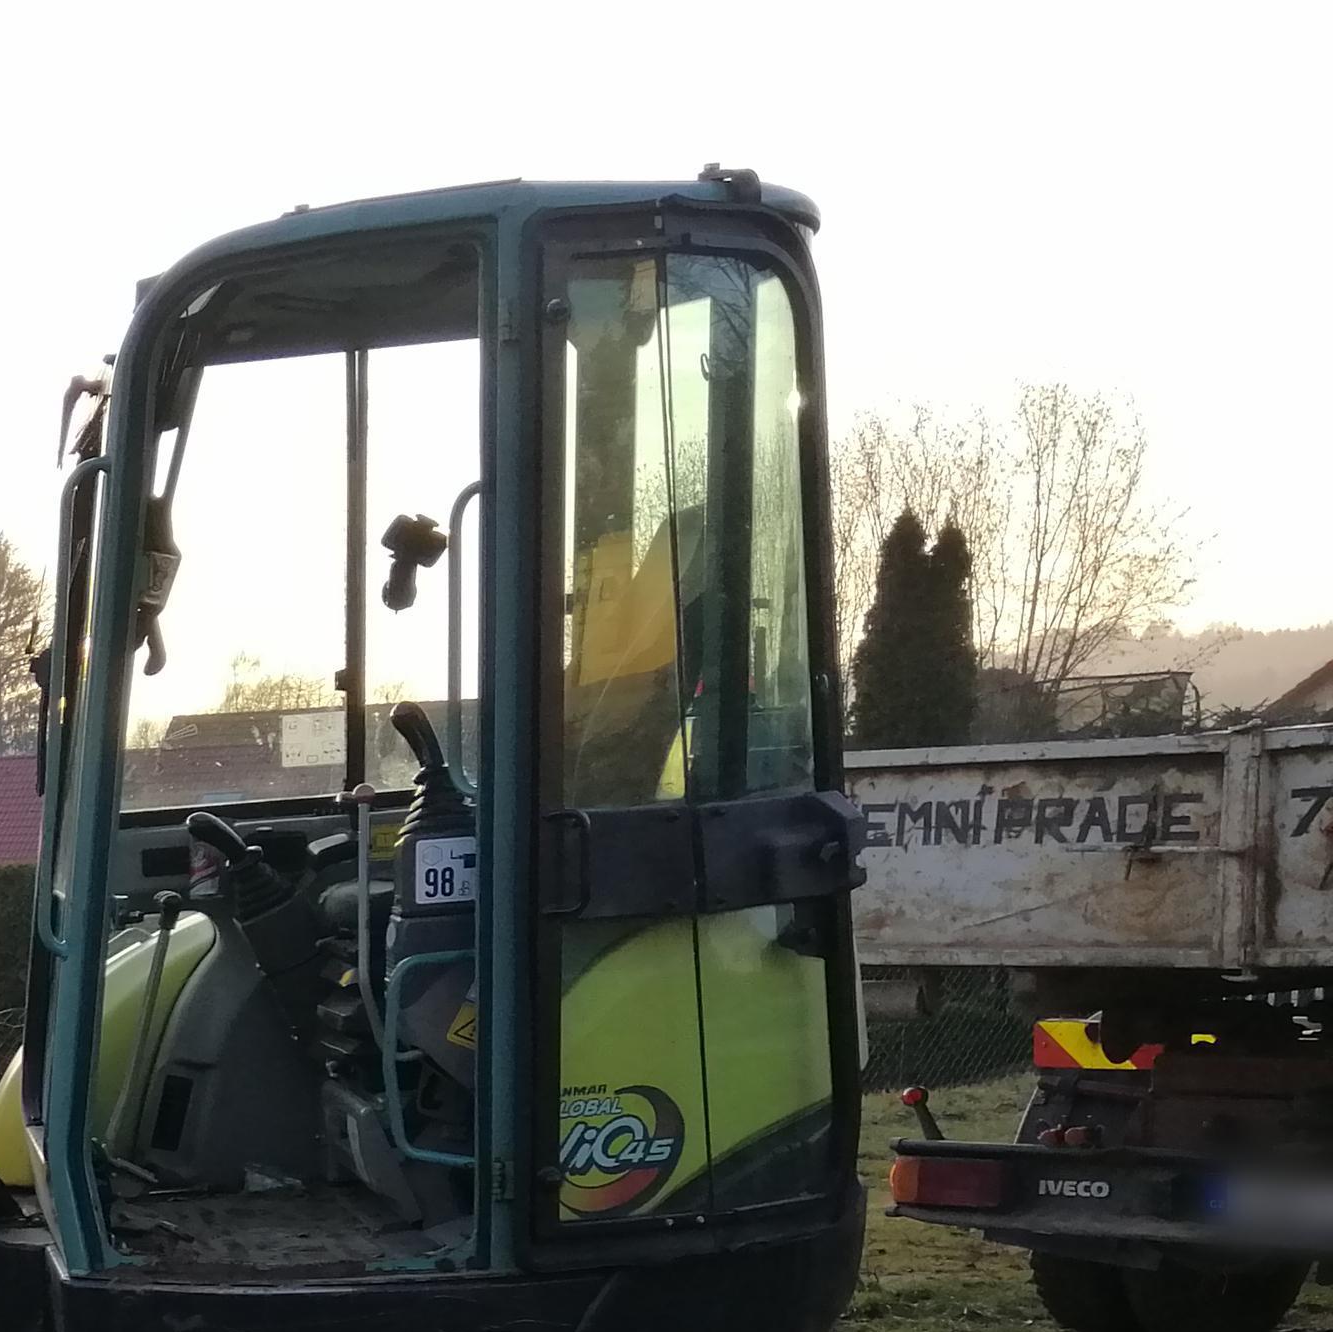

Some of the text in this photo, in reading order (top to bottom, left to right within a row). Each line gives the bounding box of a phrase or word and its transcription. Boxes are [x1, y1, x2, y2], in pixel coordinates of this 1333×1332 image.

[424, 866, 455, 898] 98
[560, 1083, 608, 1098] NMAR
[559, 1096, 623, 1119] LOBAL
[1038, 1179, 1110, 1198] IVECO
